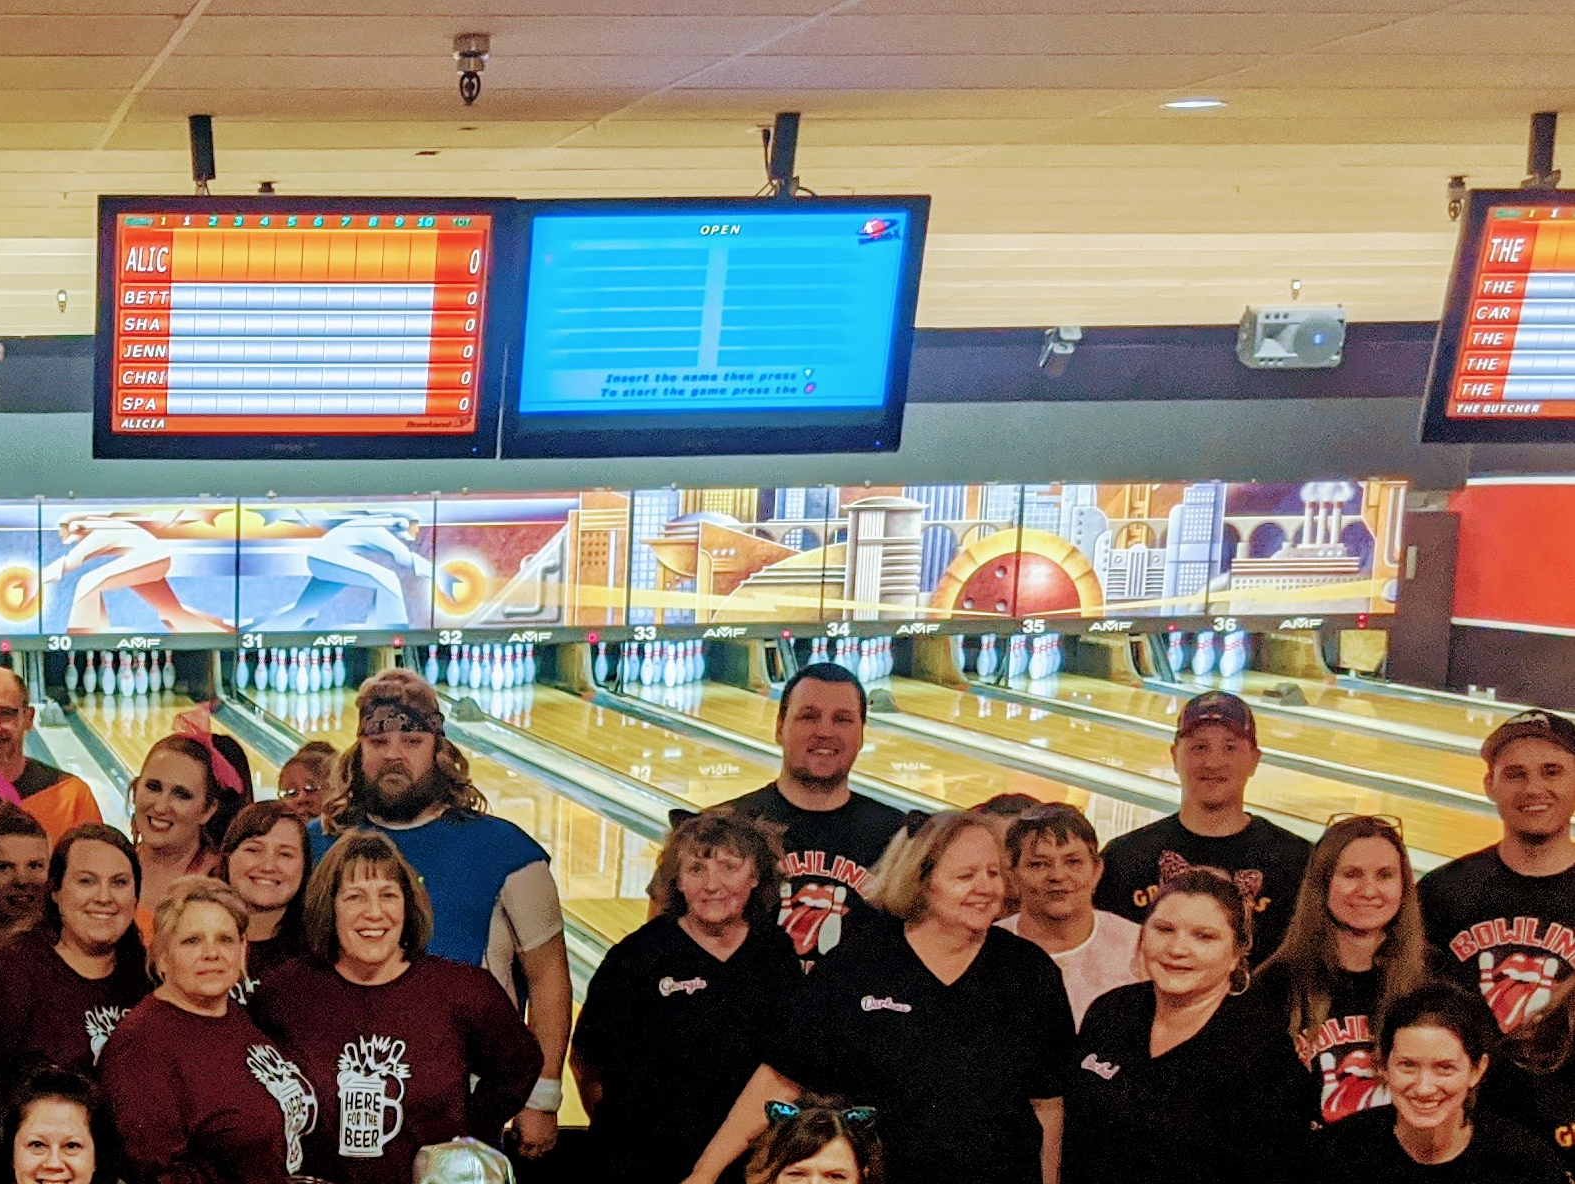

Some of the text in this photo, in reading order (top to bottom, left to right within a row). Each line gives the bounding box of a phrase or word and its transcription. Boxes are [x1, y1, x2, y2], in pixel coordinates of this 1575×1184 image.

[1529, 209, 1536, 218] 1
[1550, 209, 1559, 218] 1
[160, 216, 167, 226] 1
[183, 215, 434, 227] 1 2 3 4 5 6 7 8 9 10
[699, 224, 742, 236] OPEN
[1489, 238, 1525, 262] THE
[125, 246, 169, 273] ALIC
[469, 249, 480, 274] 0
[1483, 280, 1517, 294] THE
[124, 291, 170, 305] BETT
[467, 291, 478, 305] 0
[1476, 306, 1511, 320] CAR
[124, 317, 160, 331] SHA
[465, 318, 476, 332] 0
[1472, 332, 1504, 345] THE
[123, 344, 167, 358] JENN
[462, 344, 473, 358] 0
[1466, 358, 1500, 371] THE
[121, 371, 167, 384] CHRI
[460, 371, 471, 385] 0
[605, 371, 798, 384] Insert the name then press
[600, 384, 798, 398] To start the game press the
[1461, 383, 1494, 396] THE
[122, 397, 157, 411] SPA
[458, 397, 469, 411] 0
[1456, 404, 1542, 414] THE BUTCHER
[121, 419, 166, 429] ALICIA
[826, 622, 850, 637] 34
[896, 622, 940, 635] AMF
[1022, 618, 1046, 634] 35
[1088, 620, 1133, 632] AMF
[1213, 617, 1237, 632] 36
[1279, 617, 1324, 630] AMF
[438, 630, 463, 645] 32
[508, 630, 553, 643] AMF
[633, 626, 657, 641] 33
[702, 626, 747, 639] AMF
[48, 635, 72, 651] 30
[116, 637, 161, 649] AMF
[242, 634, 264, 649] 31
[312, 634, 358, 647] AMF
[345, 1091, 382, 1112] HERE
[347, 1111, 378, 1126] FOR THE
[344, 1129, 380, 1148] BEER
